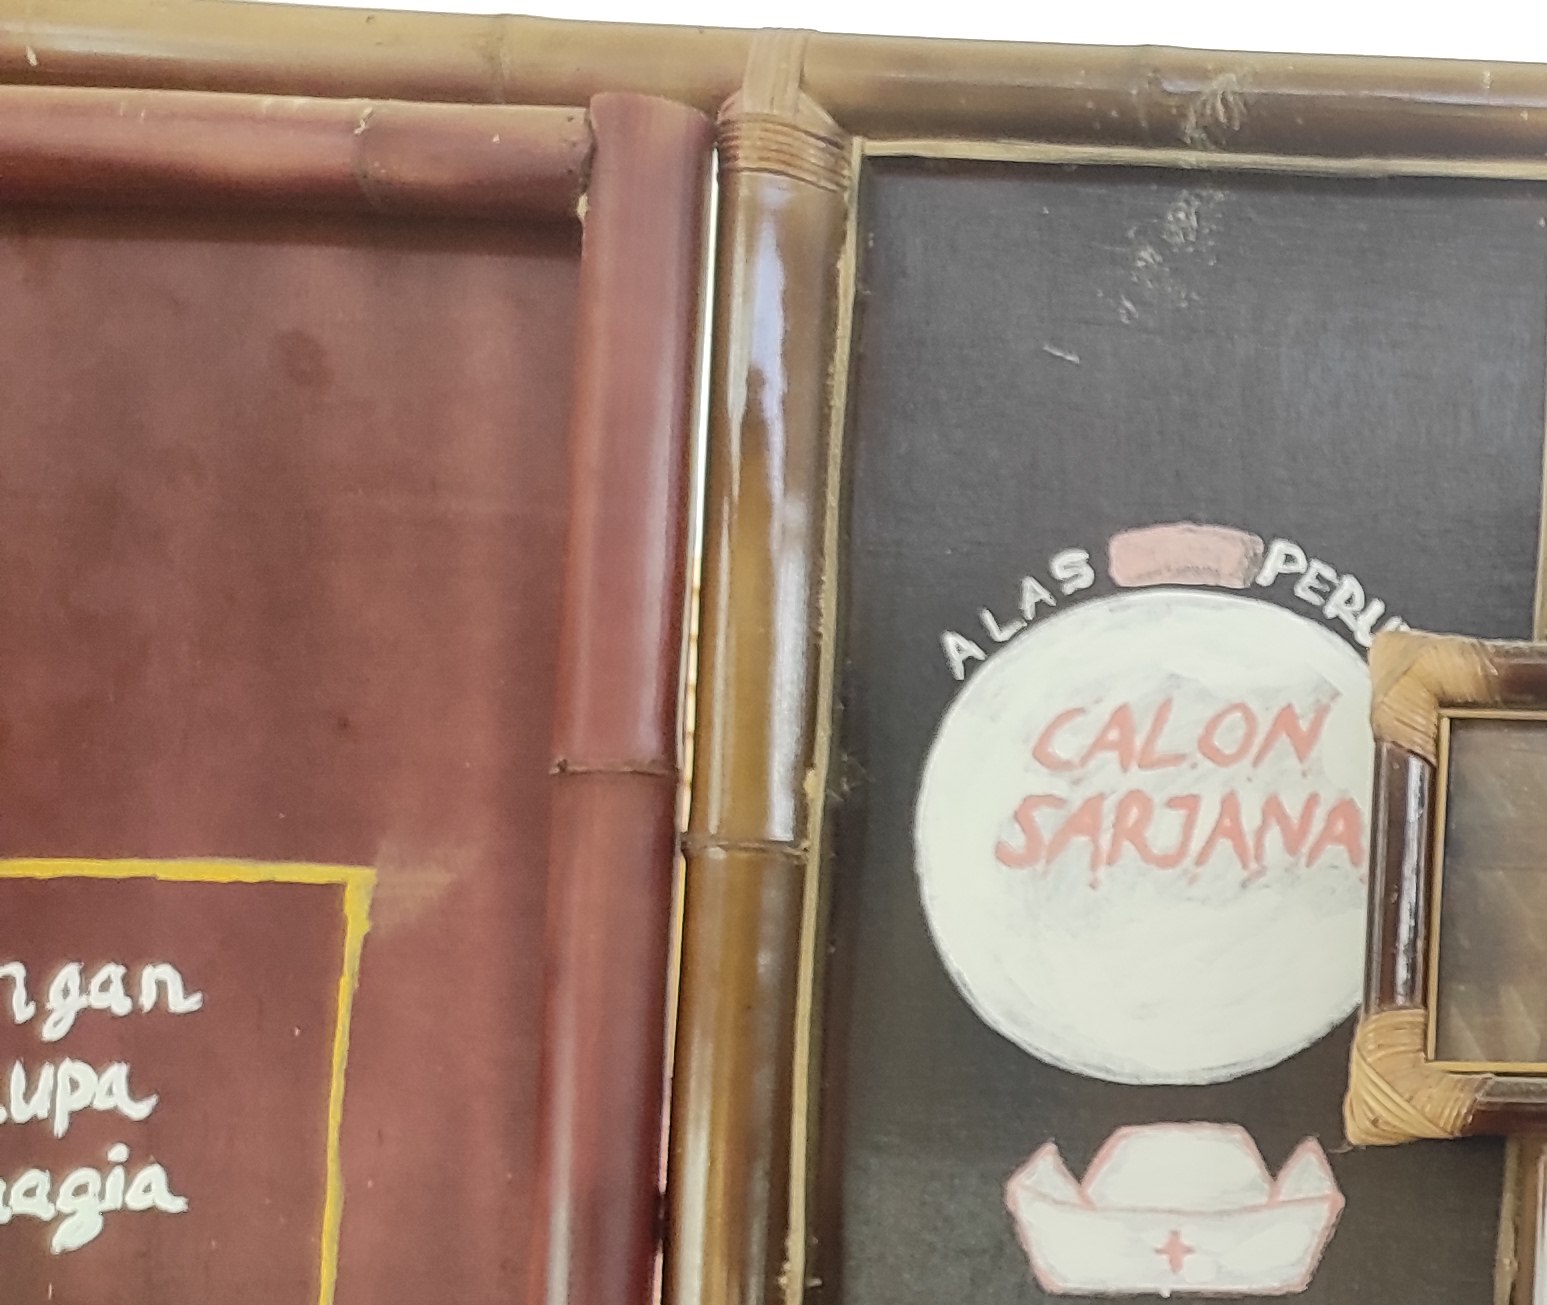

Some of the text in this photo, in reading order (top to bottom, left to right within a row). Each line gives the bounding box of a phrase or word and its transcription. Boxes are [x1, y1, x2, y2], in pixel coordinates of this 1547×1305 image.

[940, 537, 1411, 682] ALAS PERU
[1031, 698, 1332, 772] CALON
[993, 788, 1368, 870] SARJANA
[0, 1056, 160, 1139] upa
